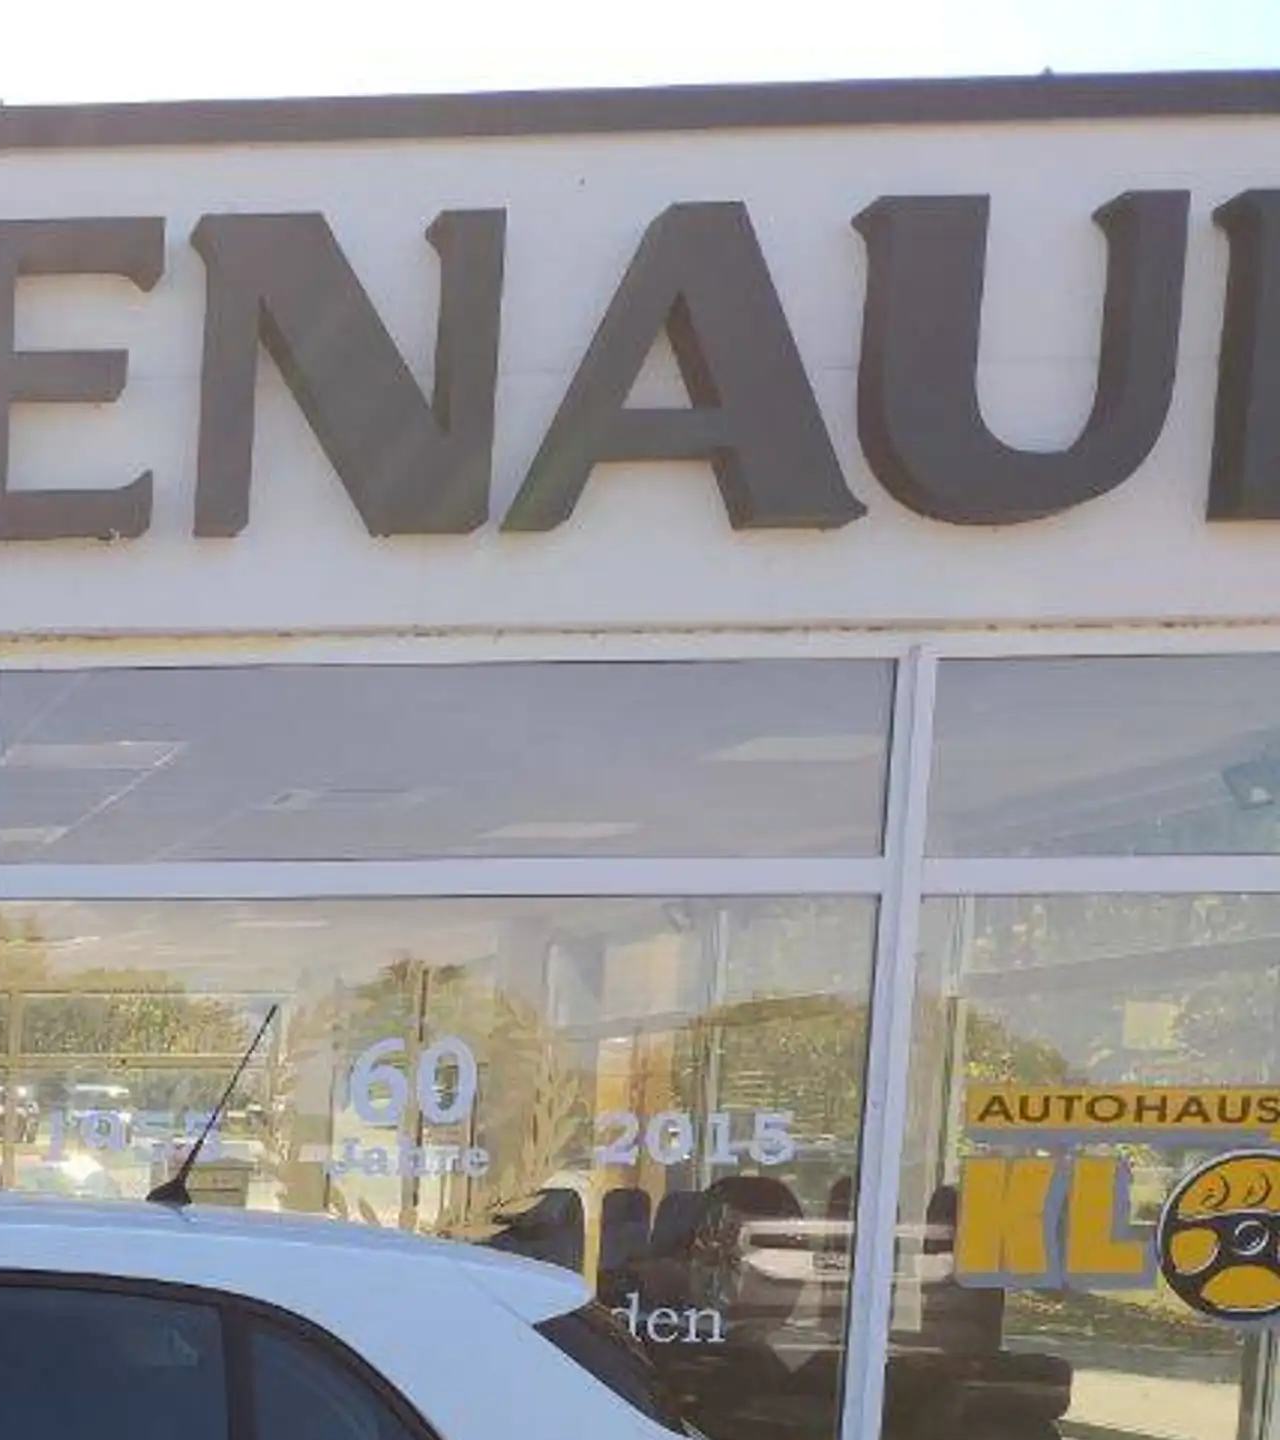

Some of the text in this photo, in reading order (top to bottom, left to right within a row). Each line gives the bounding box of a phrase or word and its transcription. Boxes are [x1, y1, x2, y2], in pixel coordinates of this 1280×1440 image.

[348, 1035, 478, 1126] 60
[977, 1093, 1280, 1125] AUTOHAUS
[324, 1136, 490, 1178] Jahre
[593, 1110, 798, 1167] 2015
